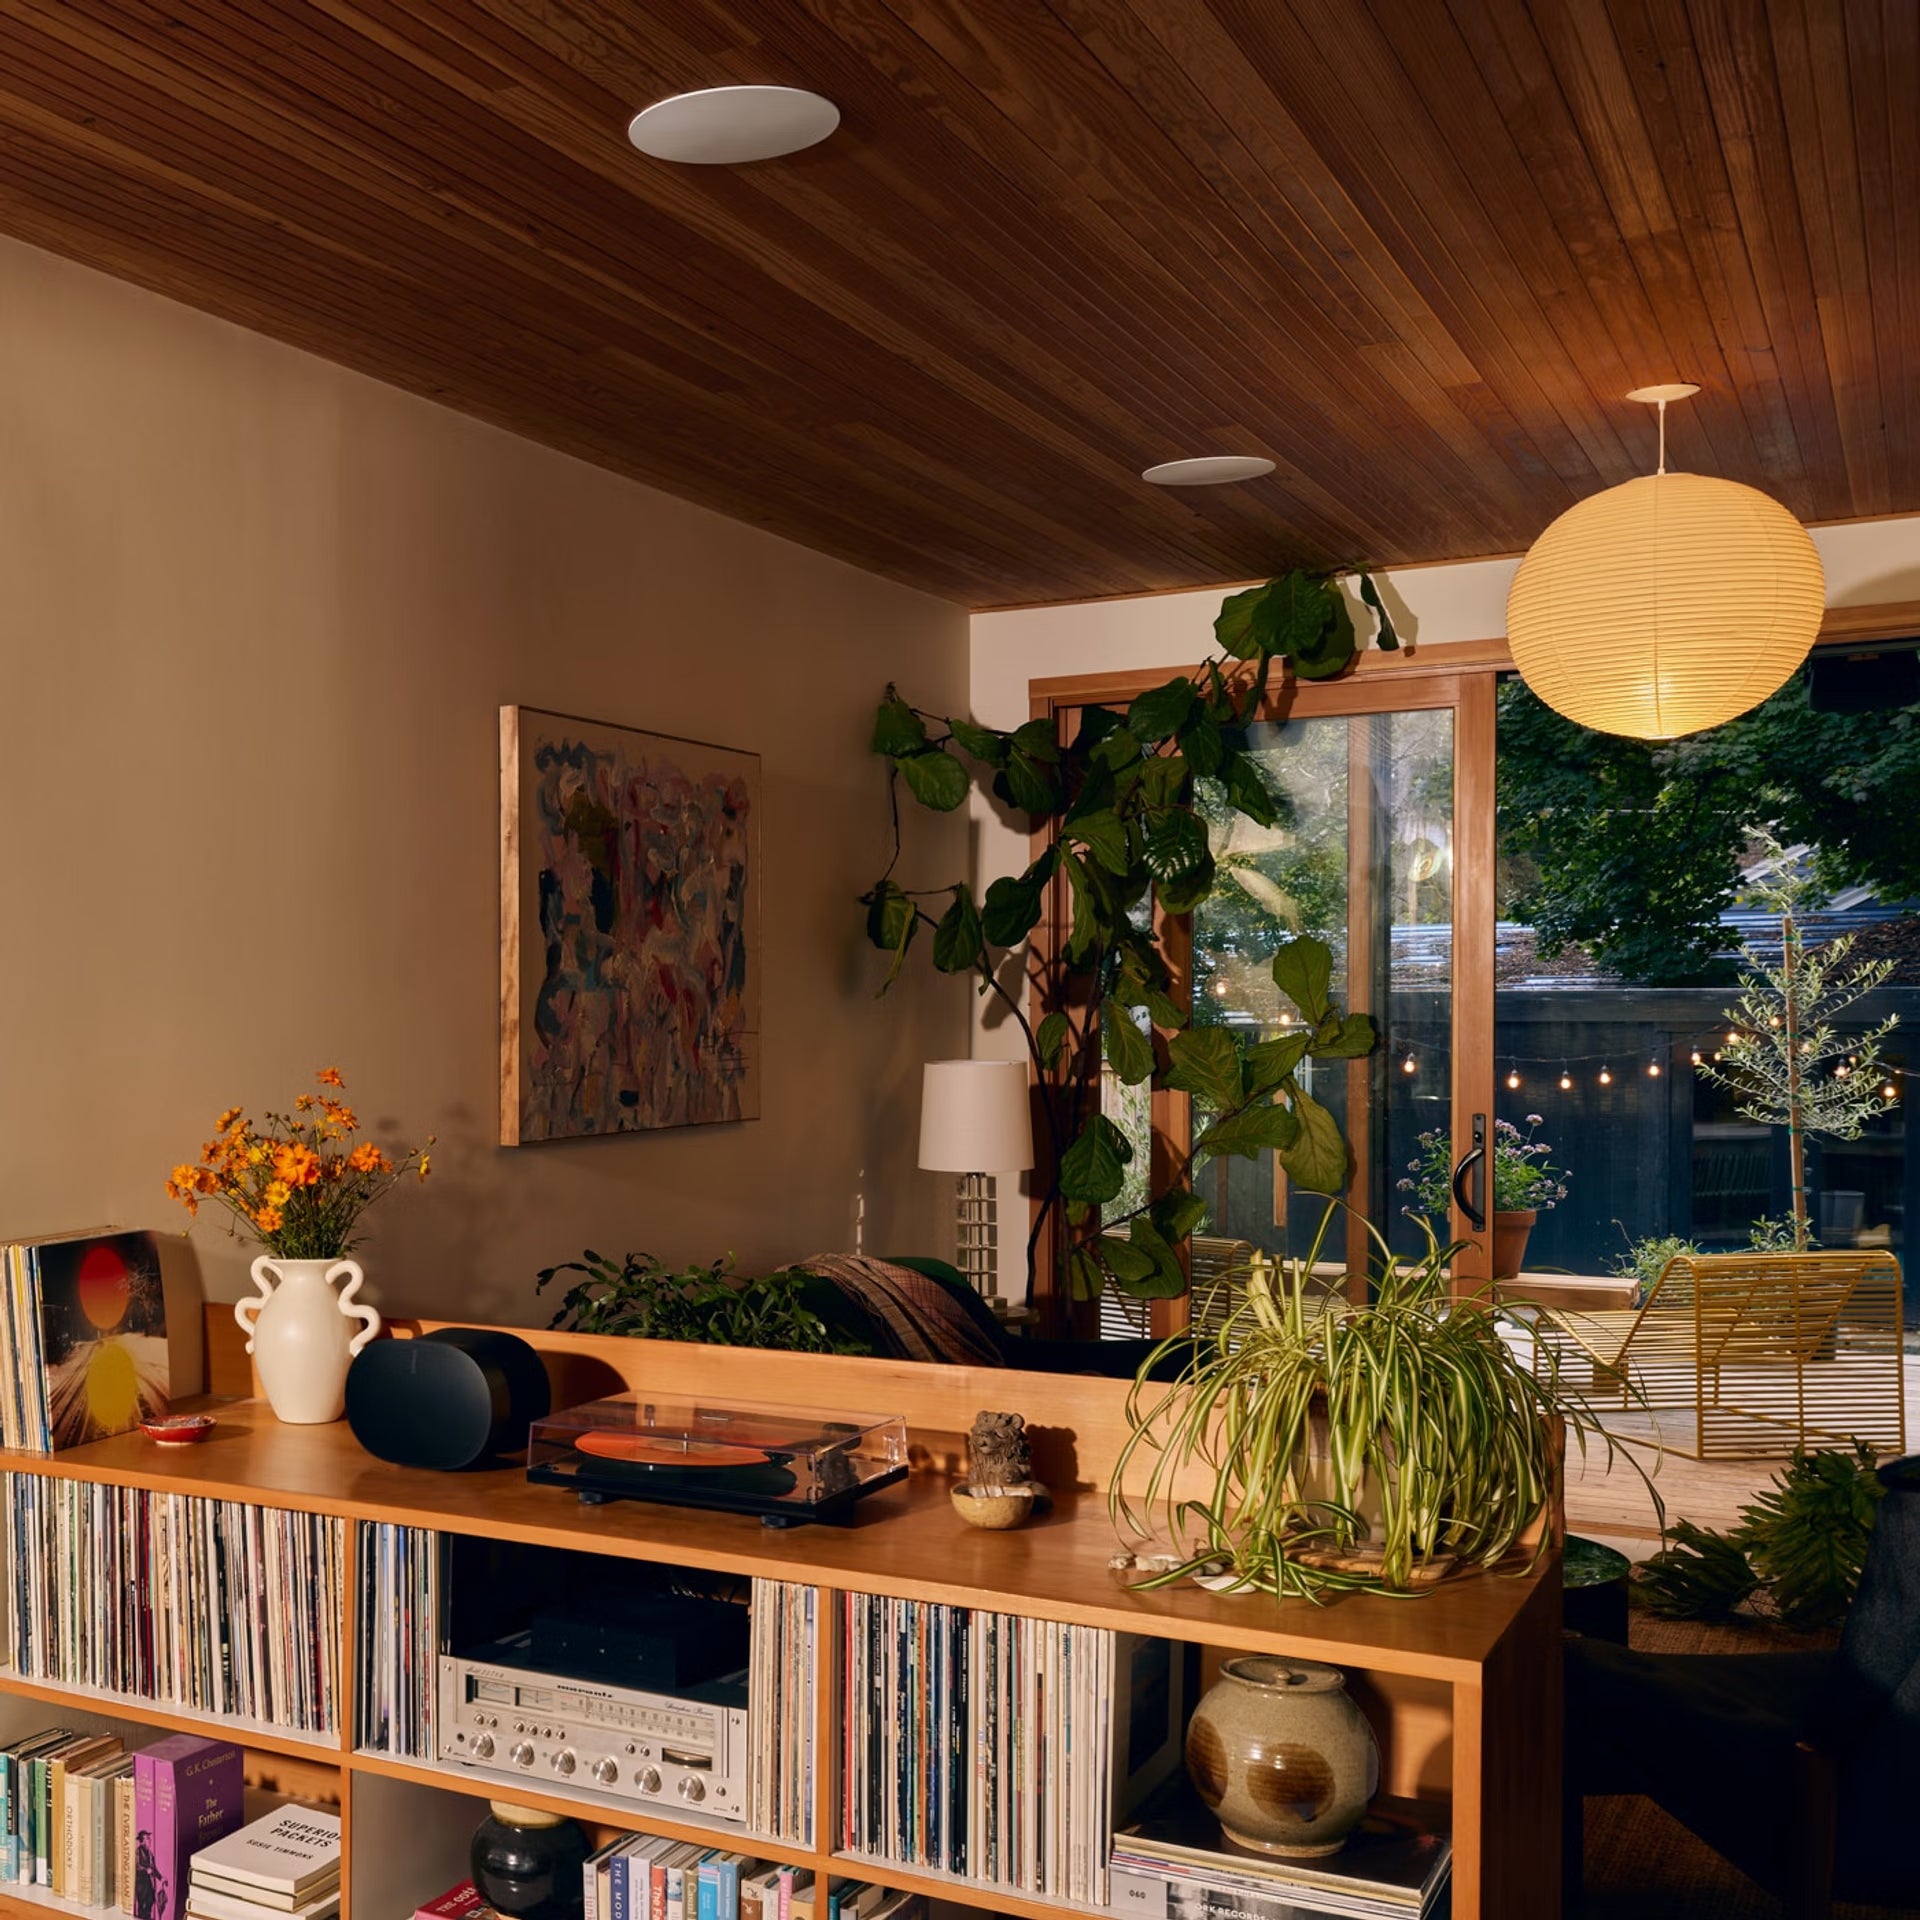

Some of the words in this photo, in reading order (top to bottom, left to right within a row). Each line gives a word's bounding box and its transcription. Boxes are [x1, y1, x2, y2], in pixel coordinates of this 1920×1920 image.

[270, 1827, 332, 1848] PACKETS
[614, 1863, 622, 1884] THE
[652, 1886, 662, 1906] The
[1128, 1889, 1146, 1899] 060
[614, 1892, 623, 1919] MOD
[1196, 1903, 1215, 1914] ORK
